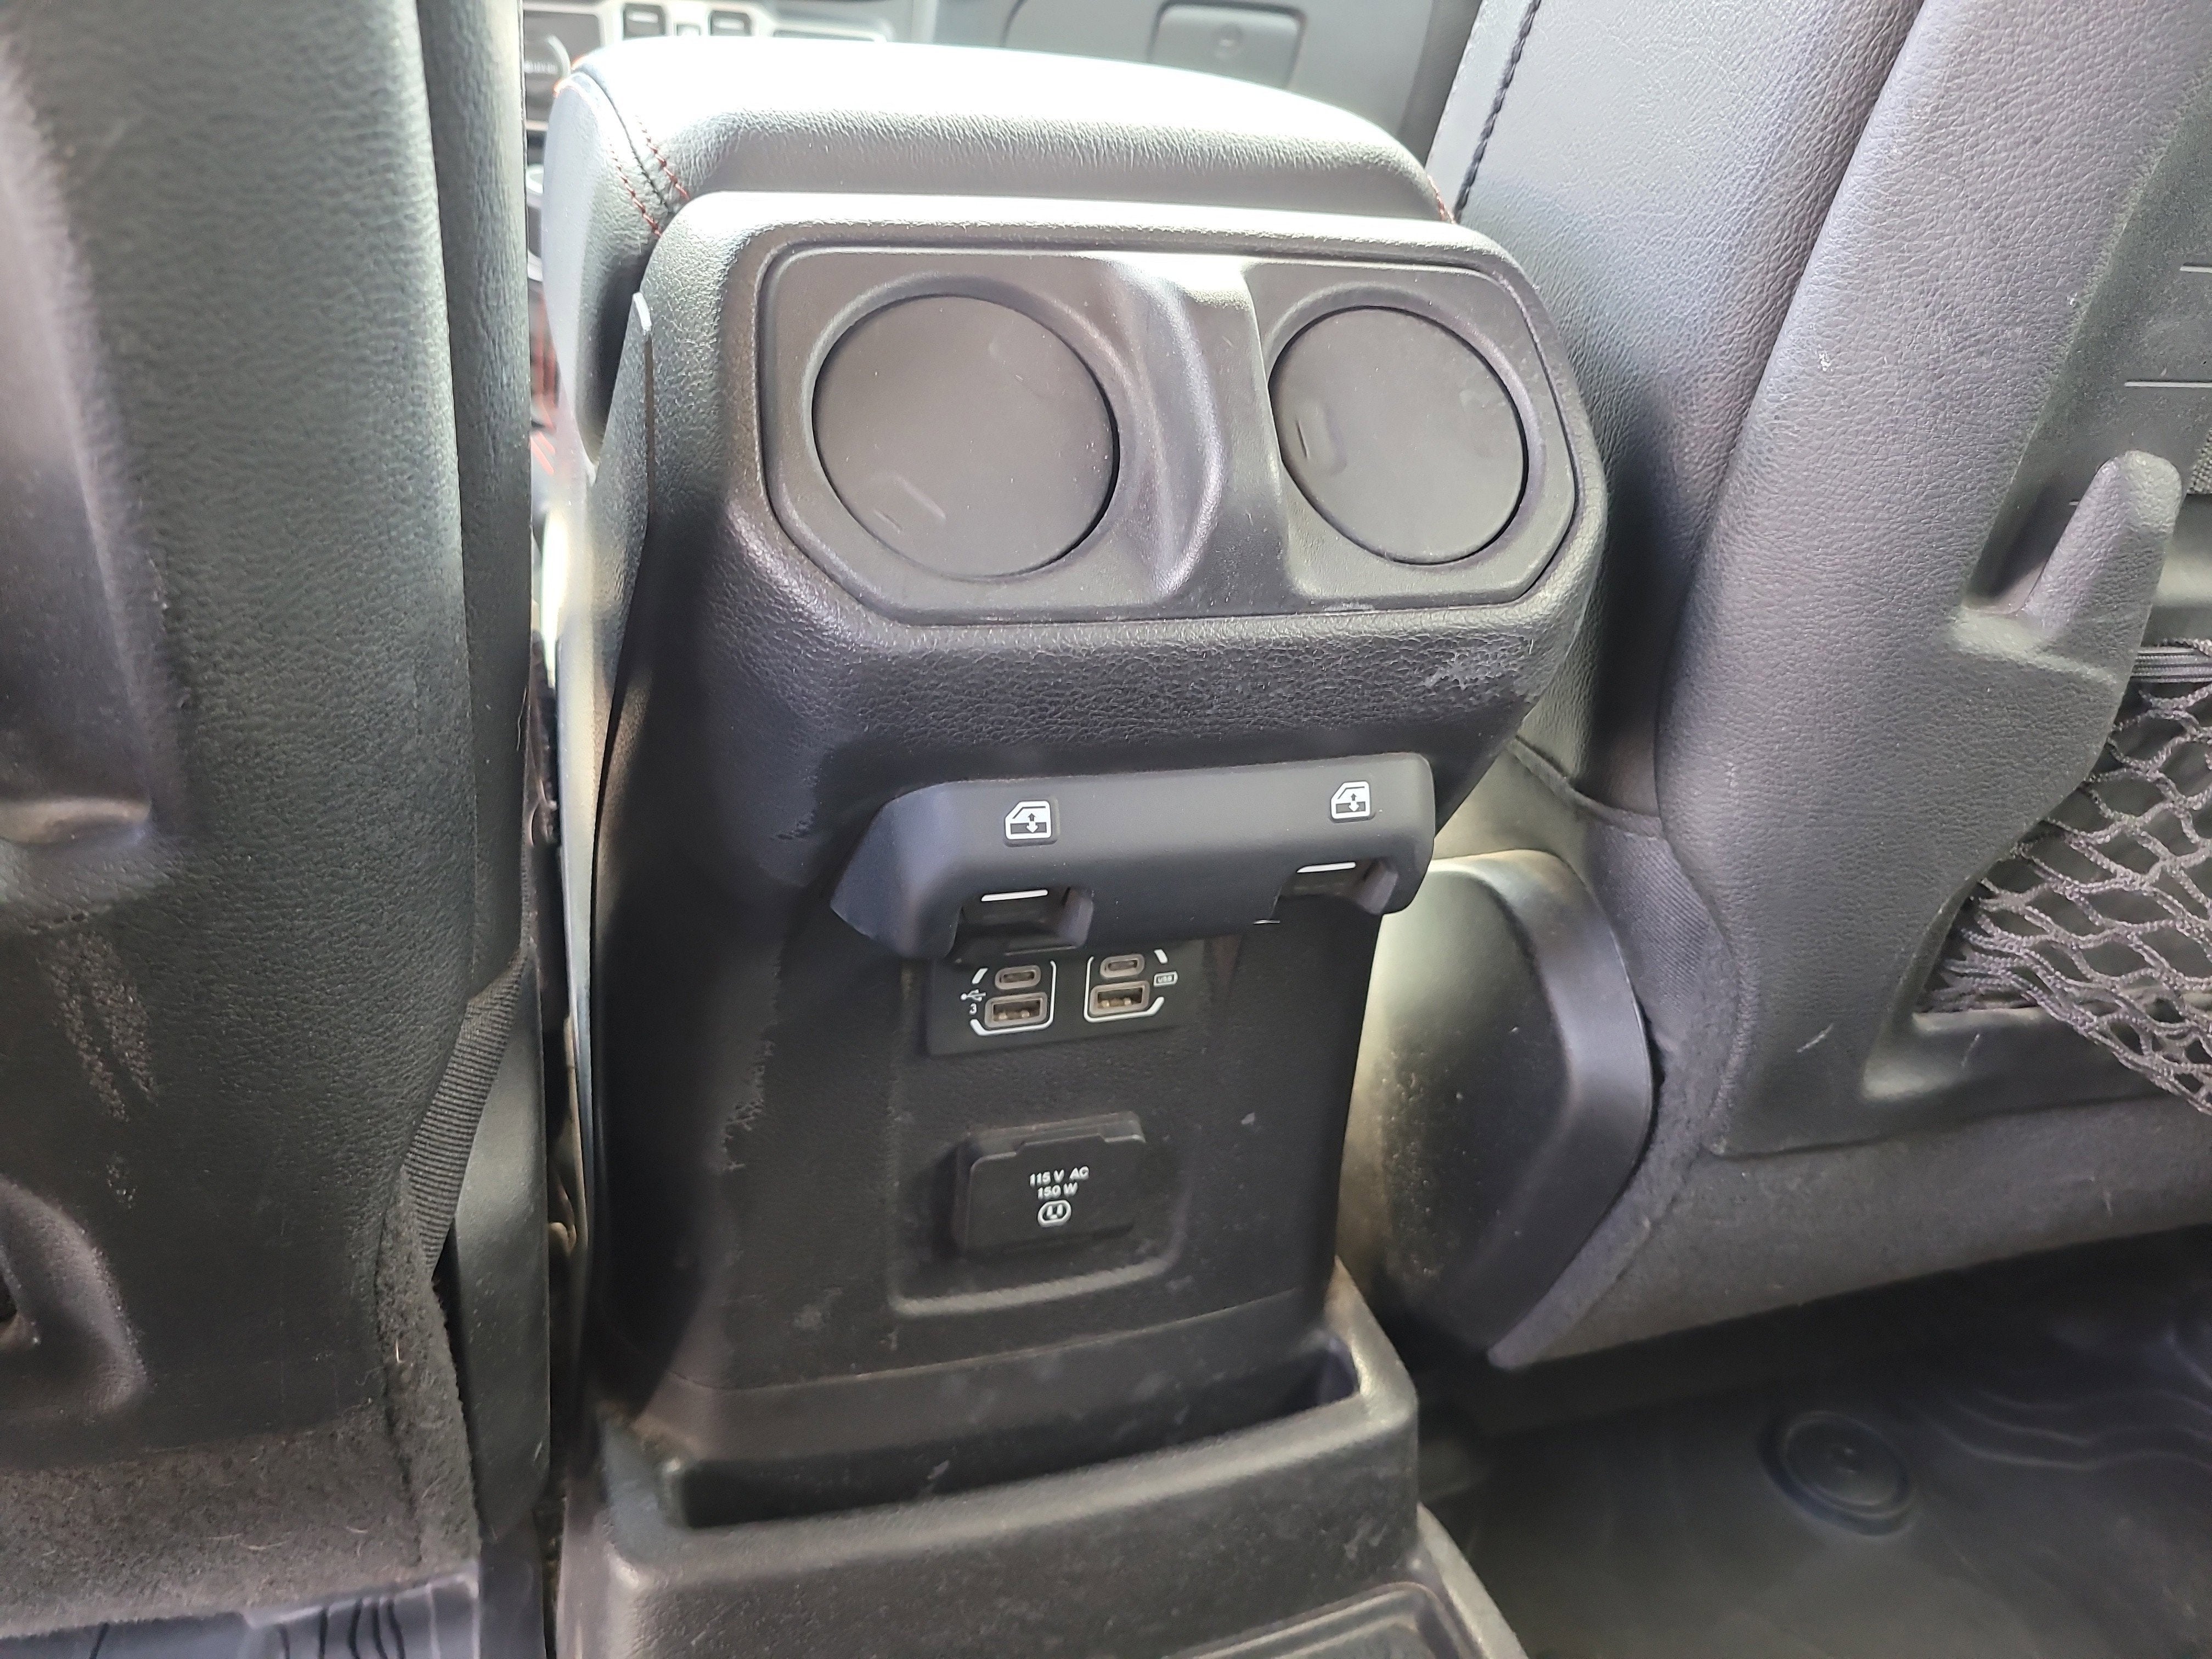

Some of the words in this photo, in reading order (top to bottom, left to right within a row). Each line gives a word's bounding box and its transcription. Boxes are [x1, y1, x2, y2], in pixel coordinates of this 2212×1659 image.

[1030, 1171, 1051, 1187] 115
[1053, 1169, 1065, 1183] V
[1069, 1166, 1090, 1180] AC
[1037, 1184, 1061, 1199] 150
[1063, 1182, 1078, 1196] W
